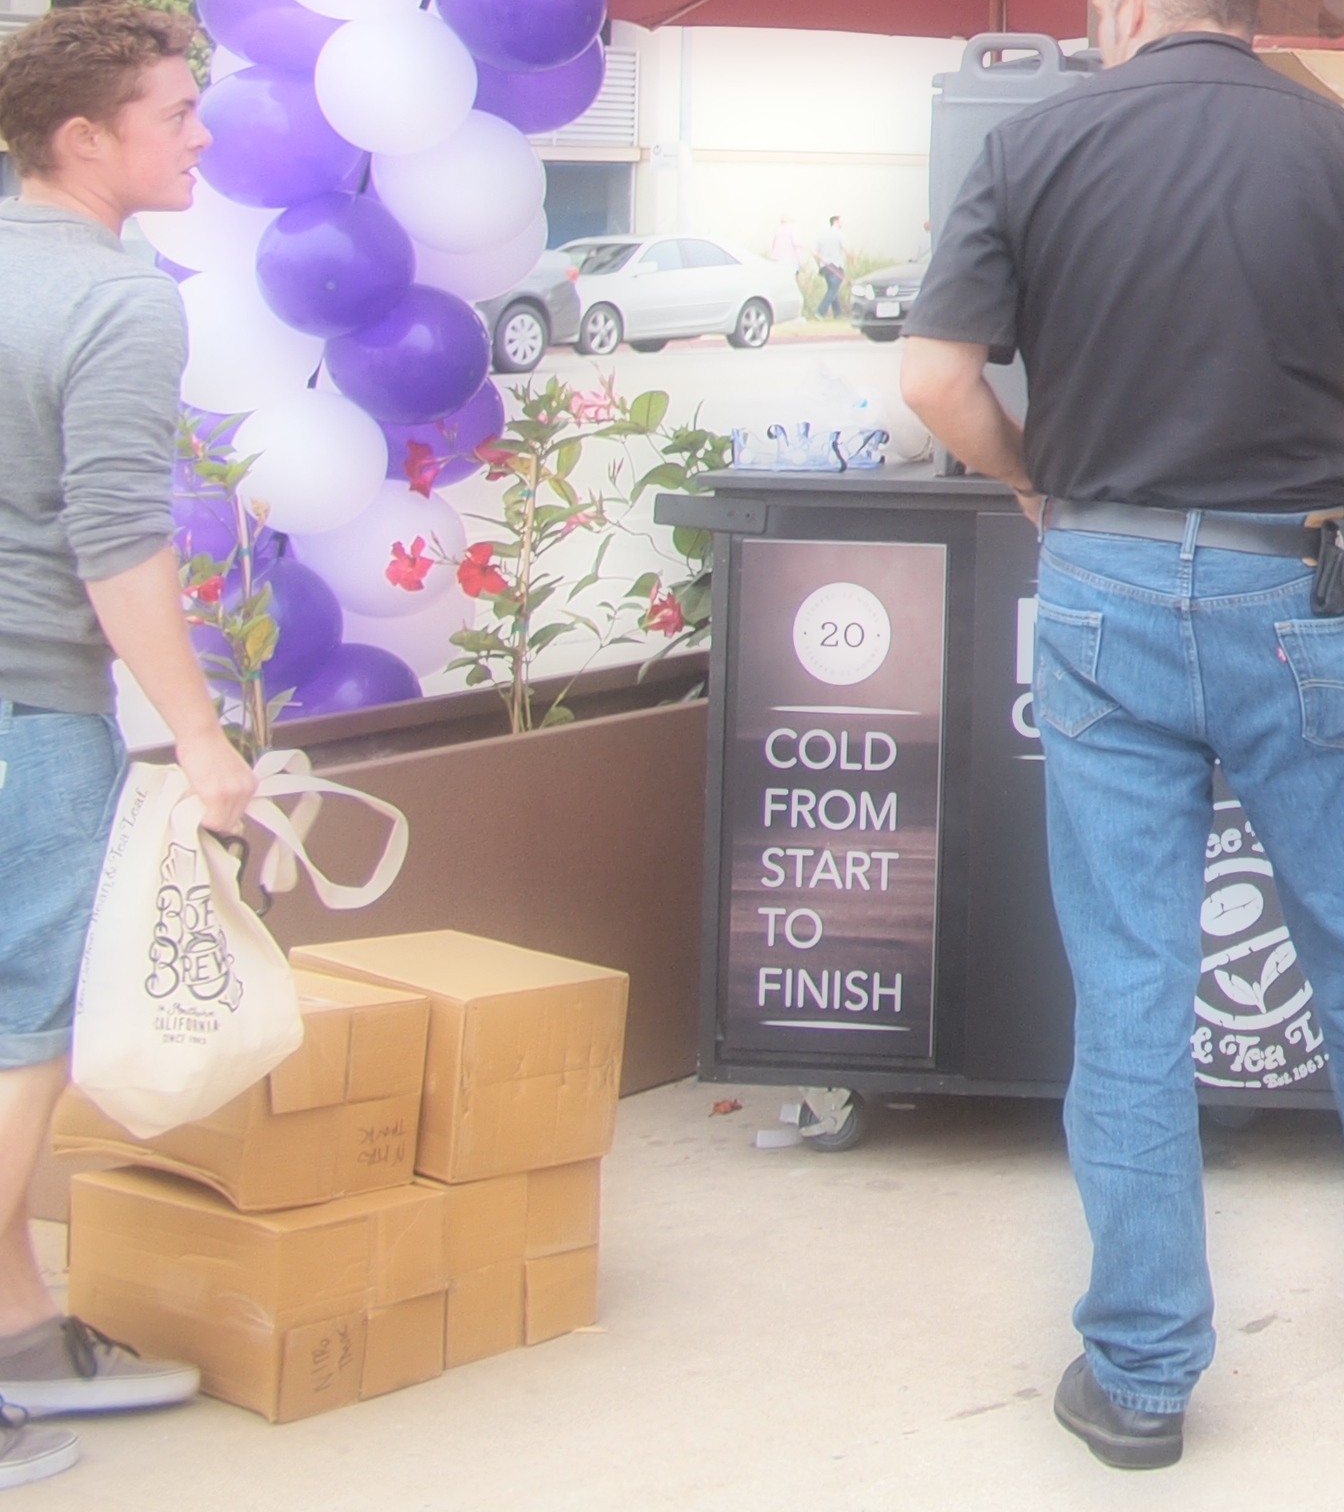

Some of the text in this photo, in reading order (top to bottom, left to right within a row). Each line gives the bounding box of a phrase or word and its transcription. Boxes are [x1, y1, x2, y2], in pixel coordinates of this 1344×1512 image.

[820, 621, 865, 648] 20
[765, 728, 897, 772] COLD
[763, 788, 897, 832] FROM
[760, 848, 899, 891] START
[758, 907, 823, 950] TO
[758, 967, 903, 1013] FINISH
[1219, 1035, 1287, 1073] Tea
